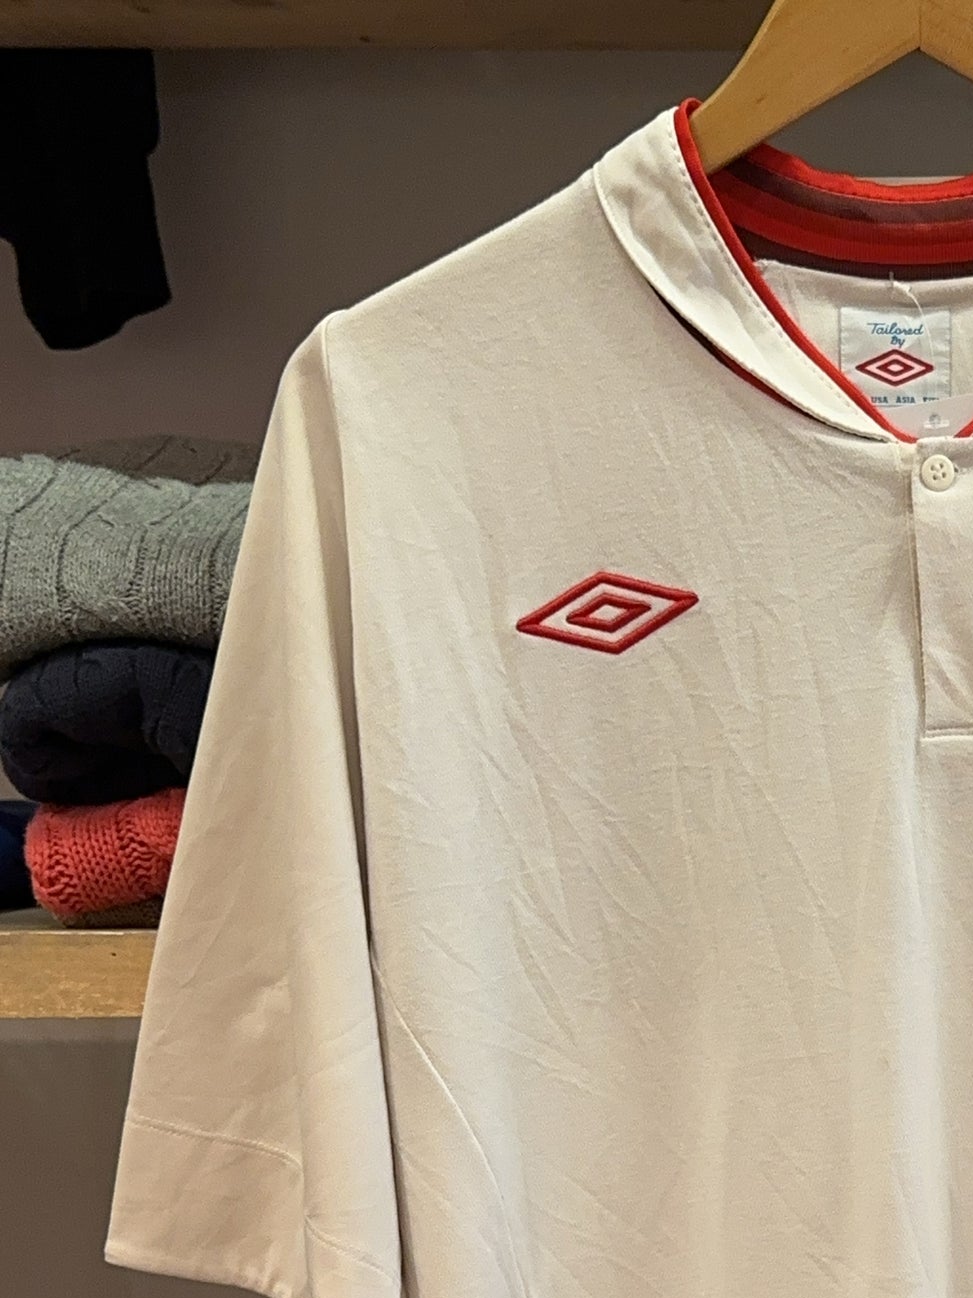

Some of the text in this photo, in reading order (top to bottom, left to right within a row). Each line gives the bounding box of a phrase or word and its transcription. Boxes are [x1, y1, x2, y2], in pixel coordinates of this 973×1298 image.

[867, 322, 924, 335] Tailored
[871, 396, 888, 404] USA
[895, 396, 916, 404] ASIA
